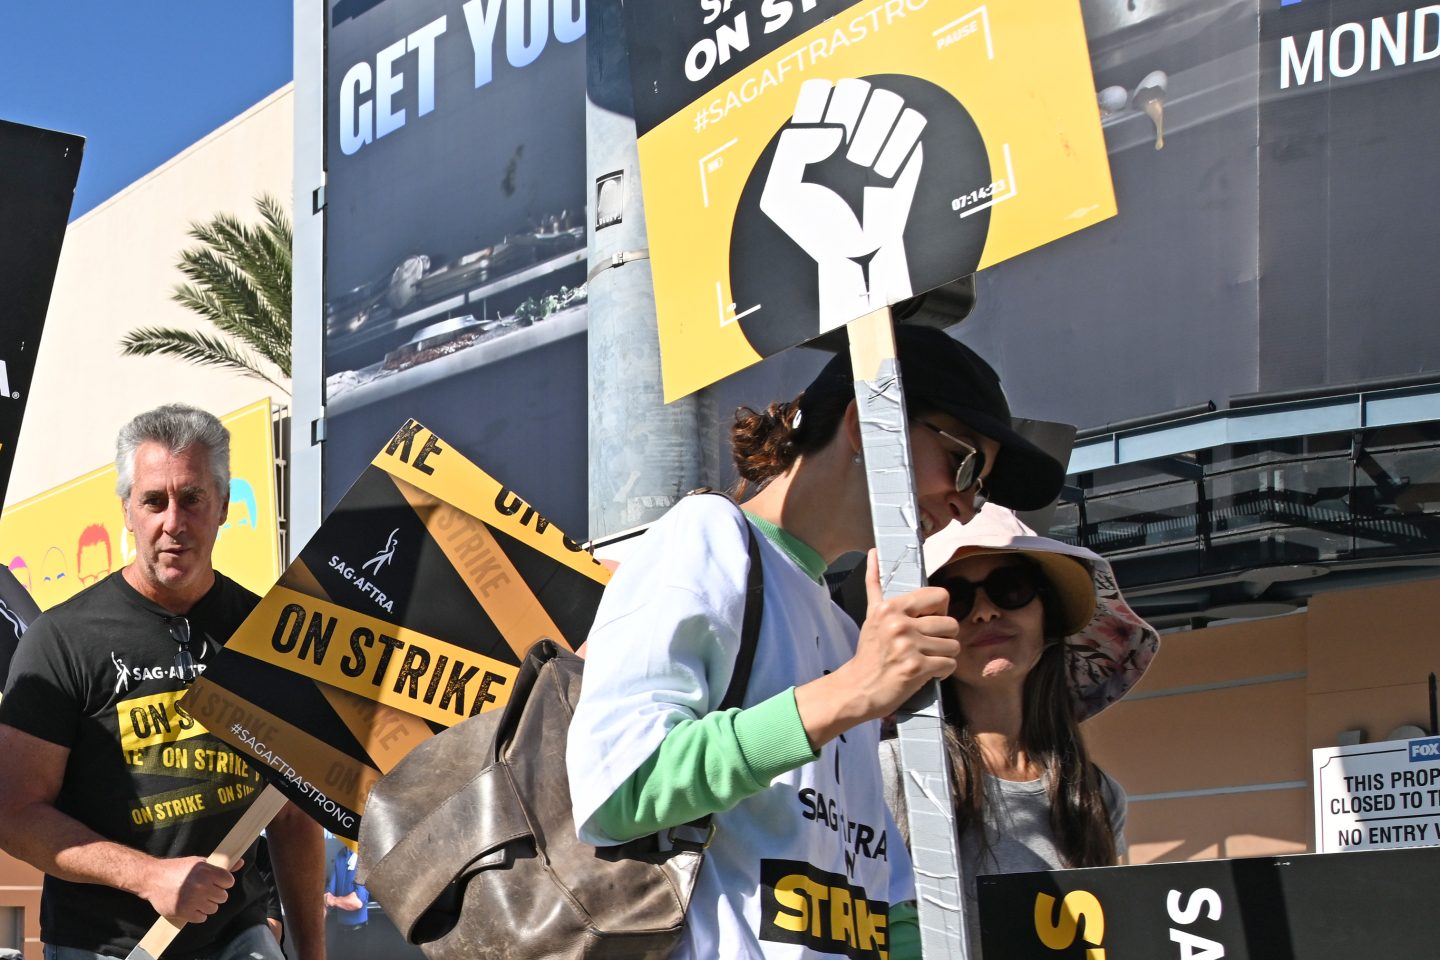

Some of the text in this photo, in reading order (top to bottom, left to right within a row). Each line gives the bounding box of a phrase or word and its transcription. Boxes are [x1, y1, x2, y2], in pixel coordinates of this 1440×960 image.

[684, 10, 750, 82] ON
[936, 20, 978, 50] PAUSE
[339, 15, 447, 155] GET
[951, 179, 1006, 212] 07:14:23
[270, 602, 507, 716] ON STRIKE
[129, 702, 171, 739] ON
[162, 747, 188, 769] ON
[194, 748, 249, 778] STRIKE
[1412, 743, 1440, 757] FOX
[230, 723, 355, 829] #SAGAFTRASTRONG
[1344, 773, 1384, 793] THIS
[131, 806, 154, 825] ON
[154, 793, 206, 820] STRIKE
[217, 785, 235, 805] ON
[1331, 793, 1395, 815] CLOSED
[1400, 791, 1422, 809] TO
[1339, 829, 1362, 847] NO
[1369, 823, 1428, 845] ENTRY
